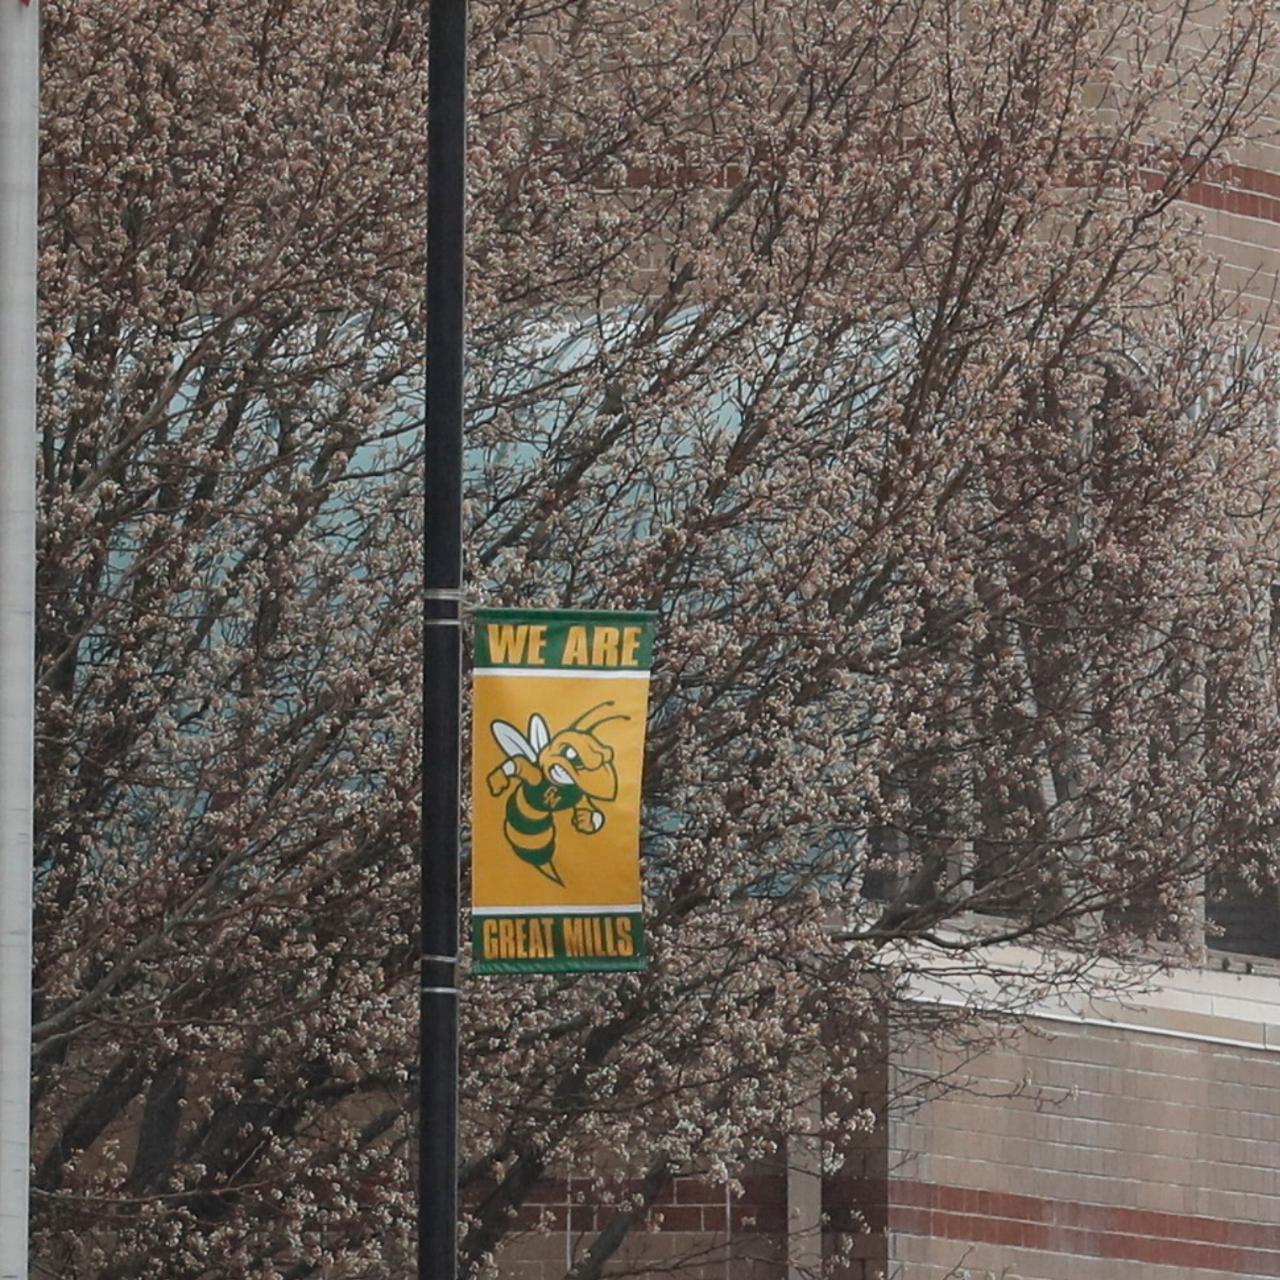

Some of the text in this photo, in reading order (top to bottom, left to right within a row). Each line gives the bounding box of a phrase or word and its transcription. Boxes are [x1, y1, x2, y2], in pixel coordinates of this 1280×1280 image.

[487, 623, 642, 668] WE ARE
[483, 916, 634, 960] GREAT MILLS
